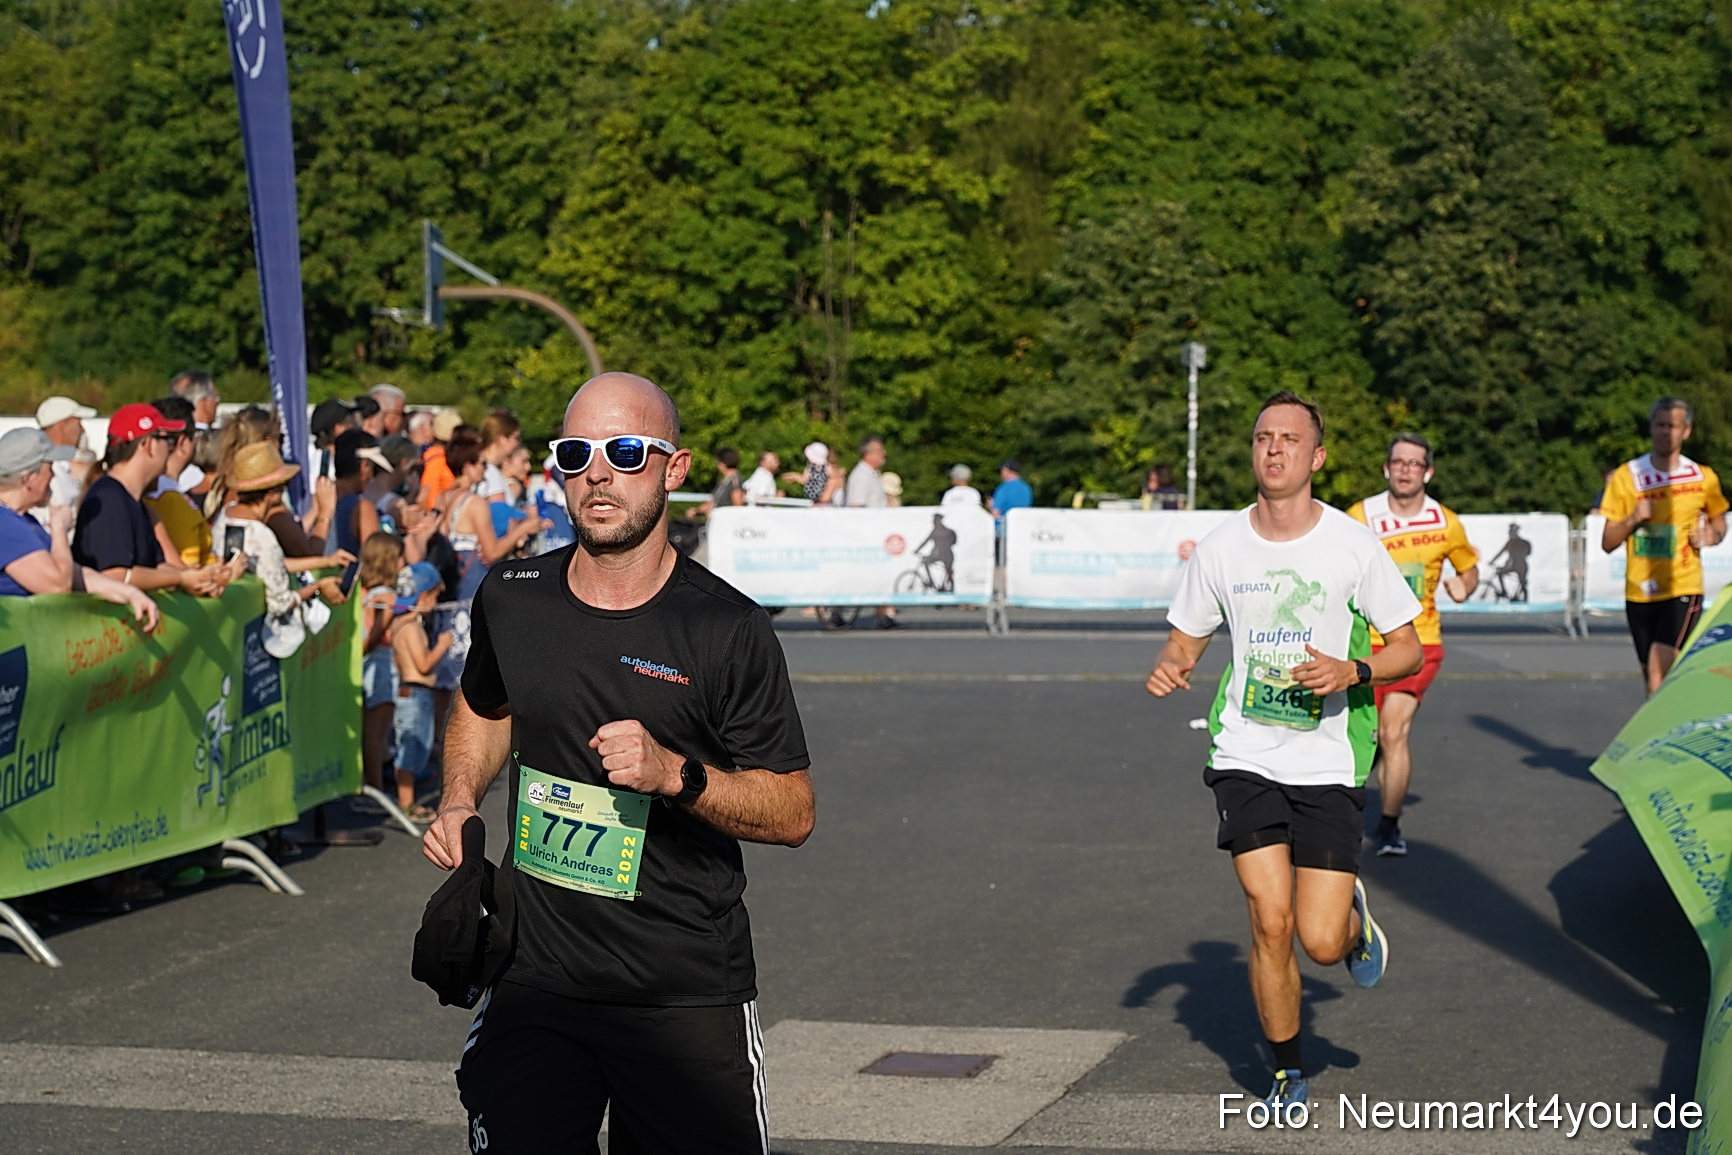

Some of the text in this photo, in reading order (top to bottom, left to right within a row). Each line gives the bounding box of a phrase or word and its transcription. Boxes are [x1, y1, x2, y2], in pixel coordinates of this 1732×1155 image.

[1386, 538, 1405, 550] AX
[515, 570, 540, 579] JAKO
[1233, 582, 1271, 594] BERATA
[1250, 627, 1312, 646] Laufend
[620, 654, 678, 676] autoladen
[633, 664, 690, 685] neumarkt
[1262, 684, 1302, 708] 346
[0, 723, 66, 807] nlauf
[544, 795, 584, 809] Firmenlauf
[520, 815, 531, 851] RUN
[541, 811, 608, 857] 777
[529, 843, 558, 864] Ulrich
[560, 856, 614, 876] Andreas
[617, 836, 636, 884] 2022
